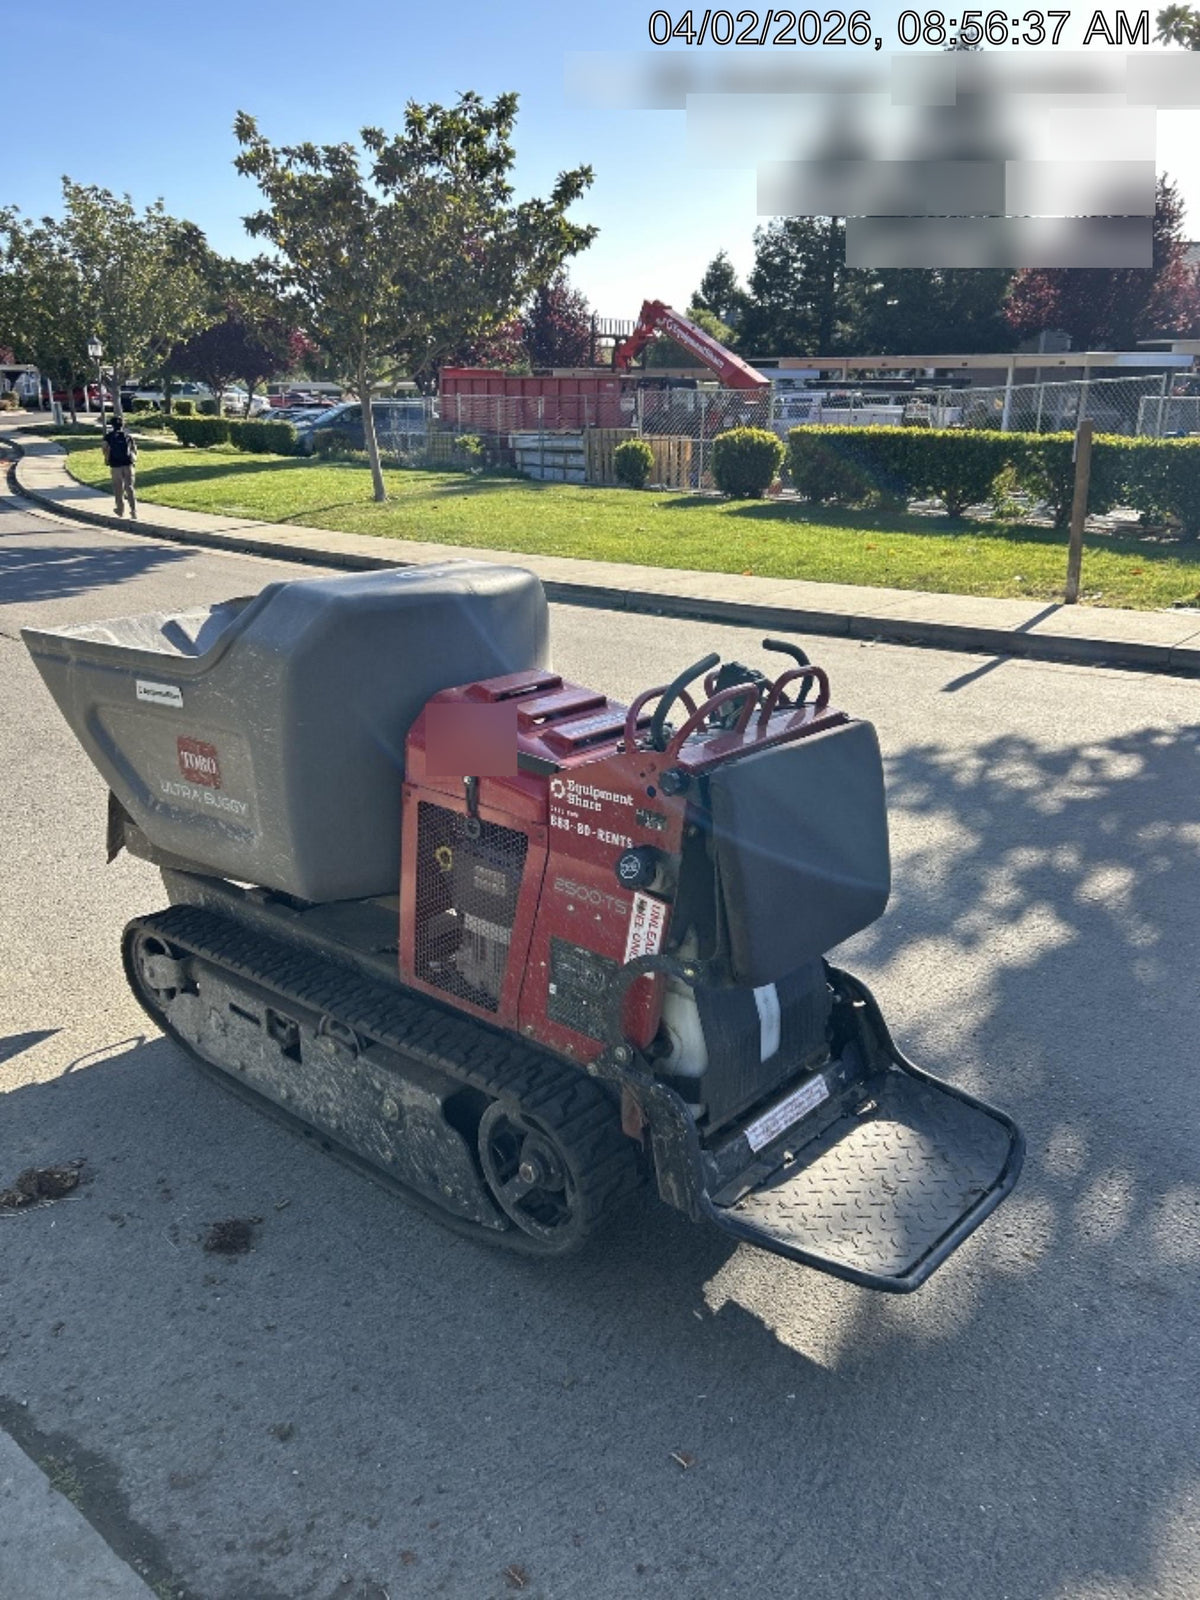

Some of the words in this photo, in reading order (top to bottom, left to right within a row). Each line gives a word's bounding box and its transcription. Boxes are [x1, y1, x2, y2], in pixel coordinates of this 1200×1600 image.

[180, 751, 217, 774] TORO
[160, 781, 201, 802] ULTRA
[203, 792, 248, 814] BUGGY
[566, 779, 634, 806] Equipment
[566, 793, 602, 812] Share
